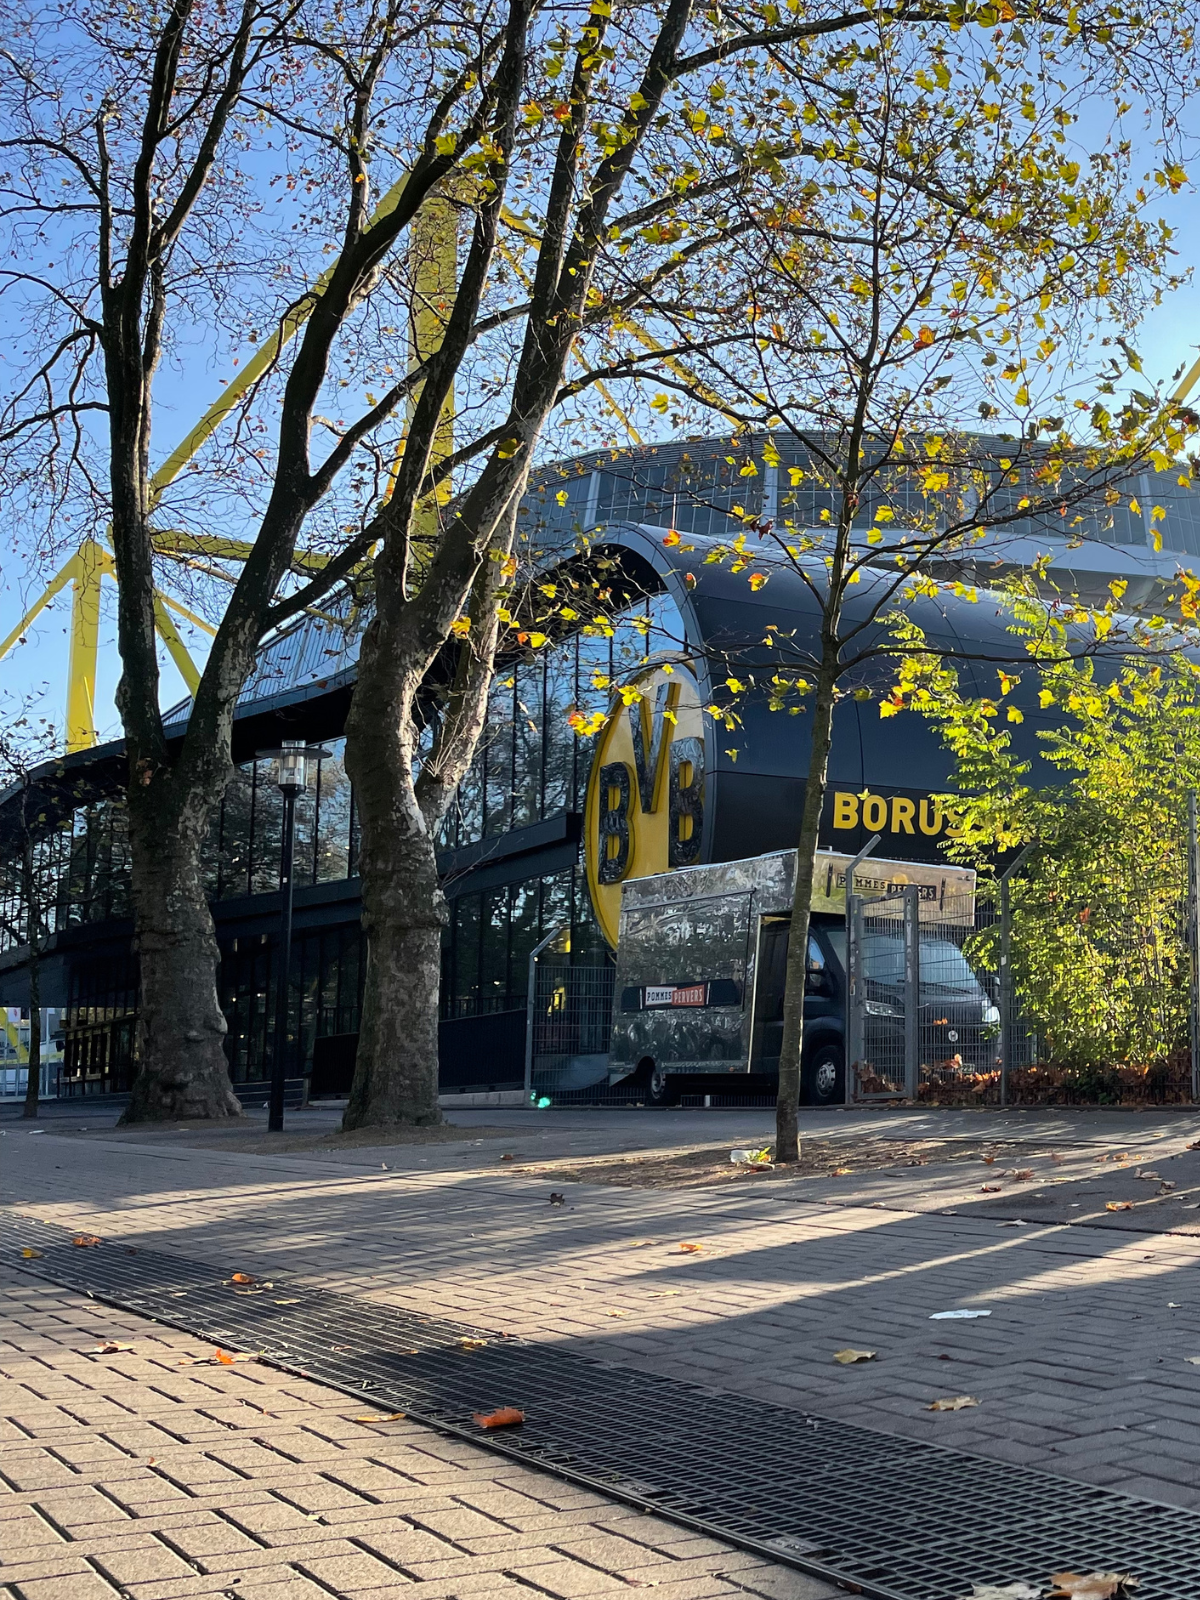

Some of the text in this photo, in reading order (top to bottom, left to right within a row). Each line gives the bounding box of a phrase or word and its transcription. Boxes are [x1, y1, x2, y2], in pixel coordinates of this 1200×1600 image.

[598, 682, 704, 885] BVB
[838, 876, 886, 889] PMMES
[646, 988, 703, 1003] POMMES PERVERS
